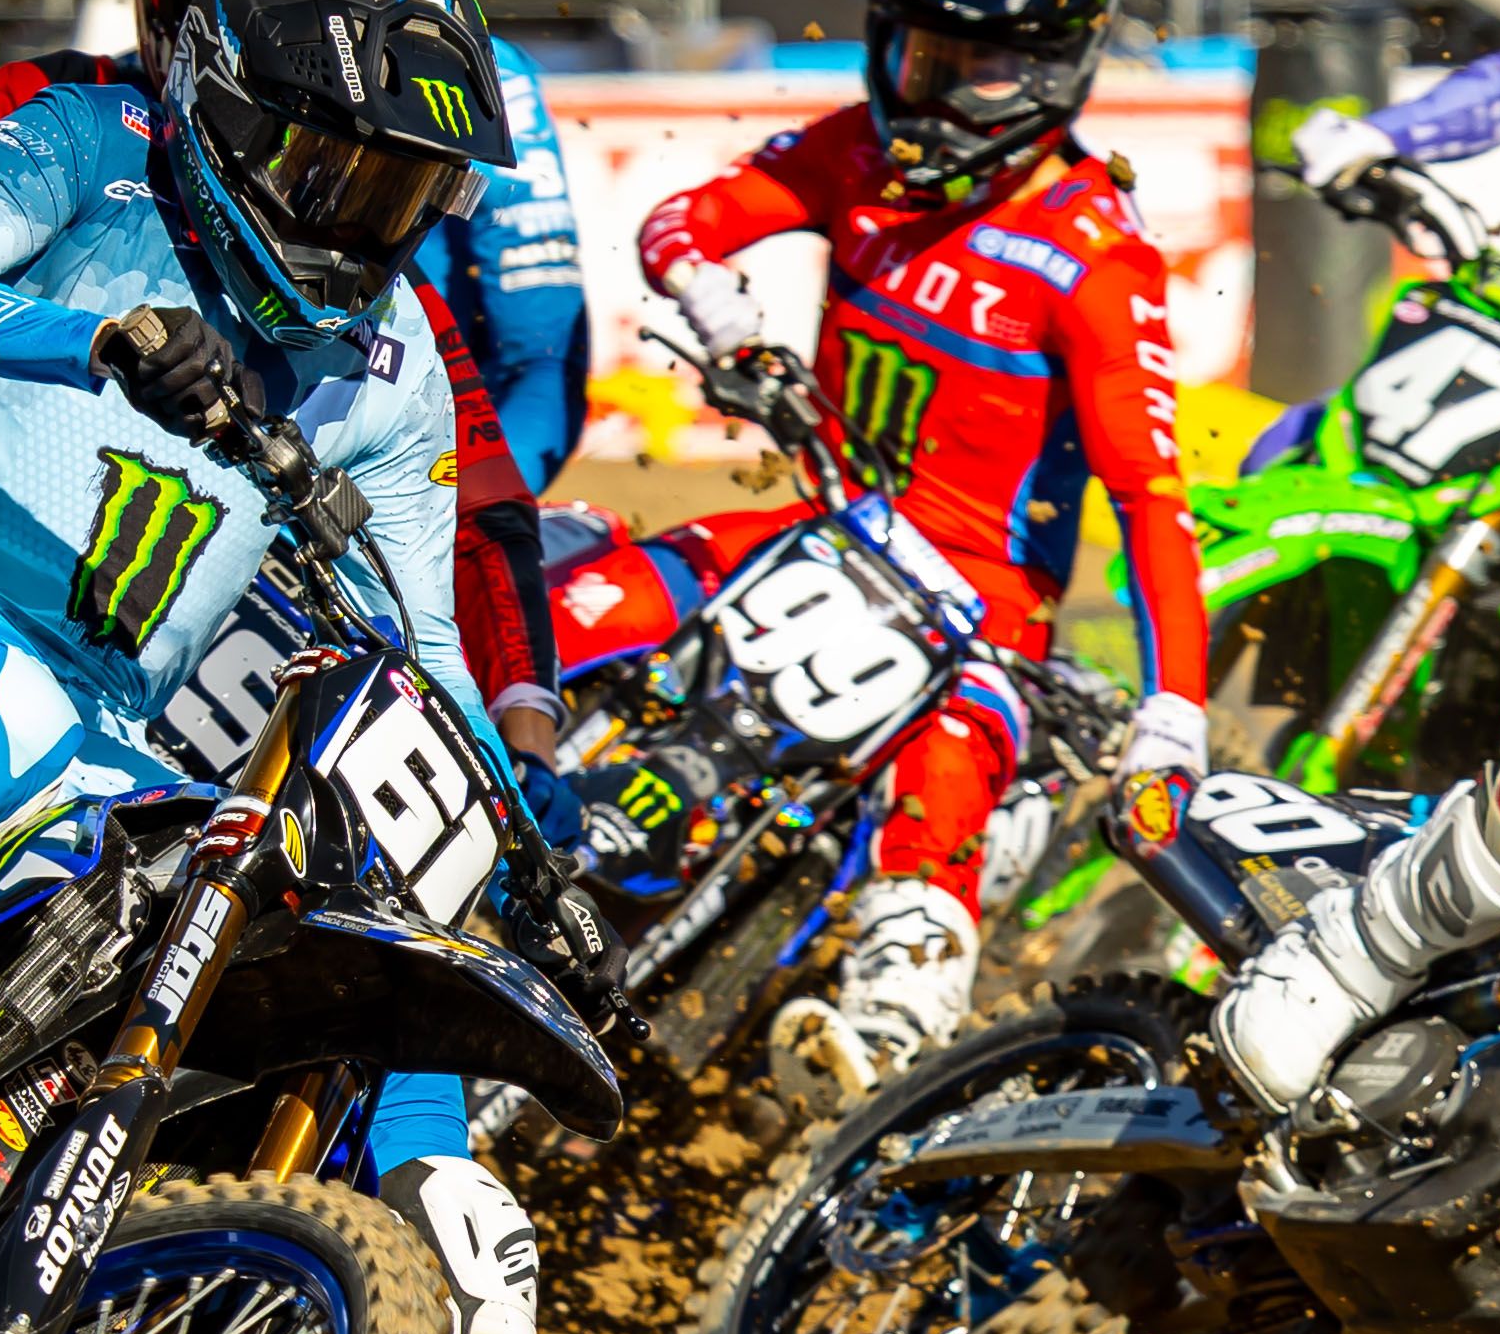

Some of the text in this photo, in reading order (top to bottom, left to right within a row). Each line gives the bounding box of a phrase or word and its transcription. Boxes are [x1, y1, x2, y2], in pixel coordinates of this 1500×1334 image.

[329, 15, 365, 103] apdesigns
[720, 559, 932, 742] 99
[427, 695, 493, 792] SUPERCROSS
[335, 697, 500, 929] 61
[1187, 772, 1368, 854] 60
[562, 897, 603, 954] ARC
[147, 943, 180, 1004] RACING
[36, 1113, 129, 1296] DUNLOP
[42, 1129, 90, 1201] BRAKING
